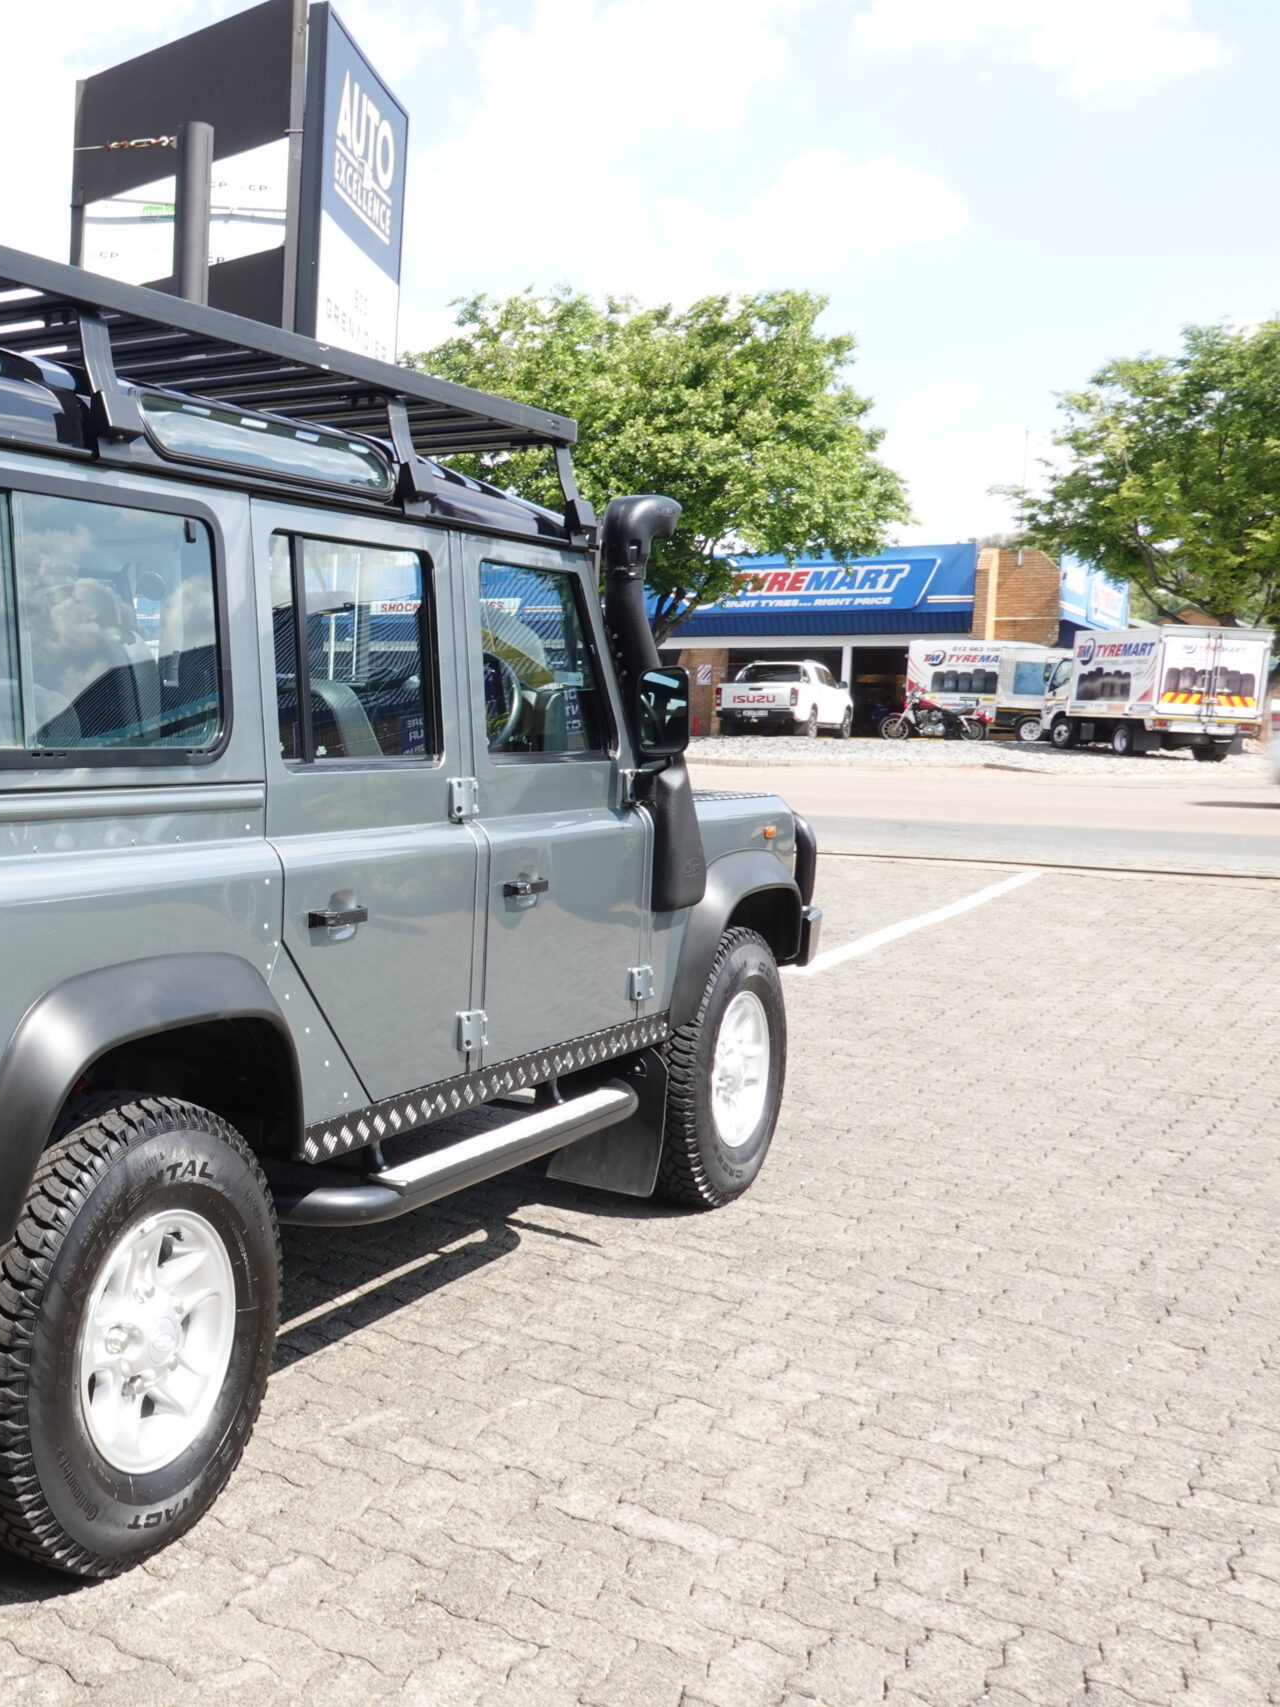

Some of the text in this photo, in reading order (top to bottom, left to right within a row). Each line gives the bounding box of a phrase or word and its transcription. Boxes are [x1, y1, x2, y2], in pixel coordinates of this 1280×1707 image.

[336, 69, 395, 191] AUTO
[333, 149, 392, 236] EXCELLENCE
[731, 566, 909, 593] TYREMART
[814, 597, 852, 606] RIGHT
[853, 596, 893, 605] PRICE
[1095, 642, 1156, 657] TYREMART
[733, 695, 776, 704] ISUZU
